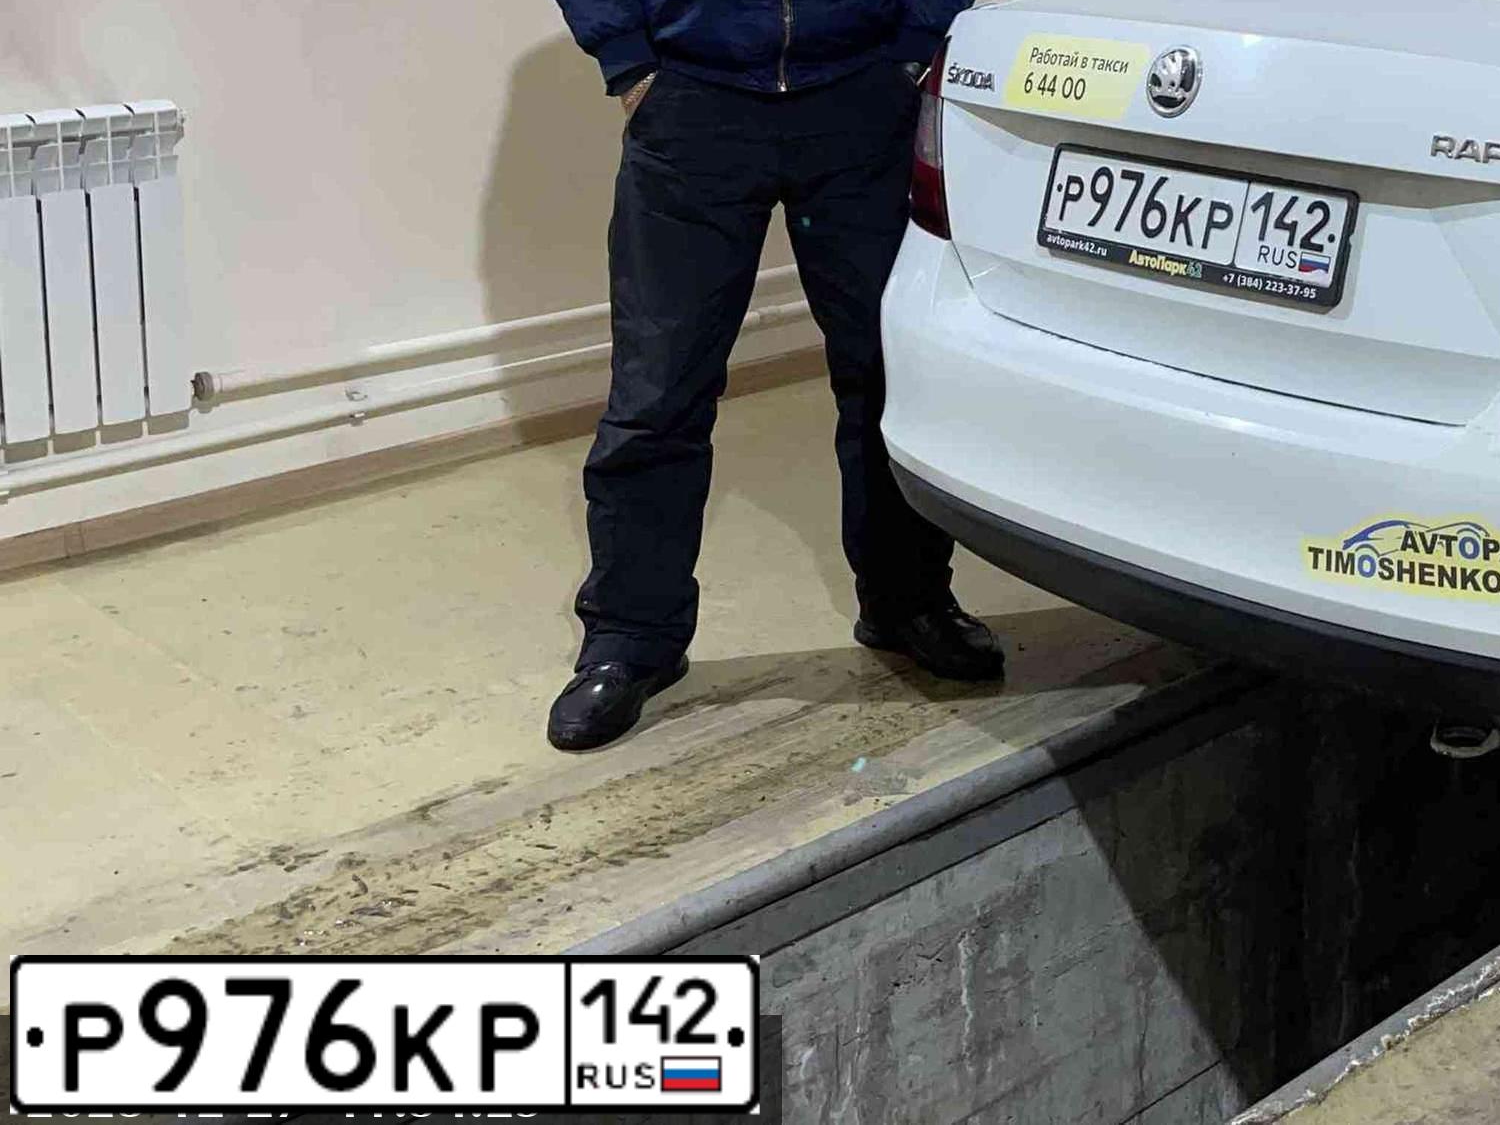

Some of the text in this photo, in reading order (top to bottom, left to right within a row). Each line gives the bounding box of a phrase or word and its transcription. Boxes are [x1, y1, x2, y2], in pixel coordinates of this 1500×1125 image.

[1029, 47, 1129, 74] Работай в такси
[1023, 72, 1087, 101] 6 44 00
[1250, 191, 1332, 253] 142
[1046, 233, 1107, 256] avtopark42.ru
[1257, 245, 1297, 269] RUS
[1222, 273, 1317, 298] +7 (384) 223-37-95
